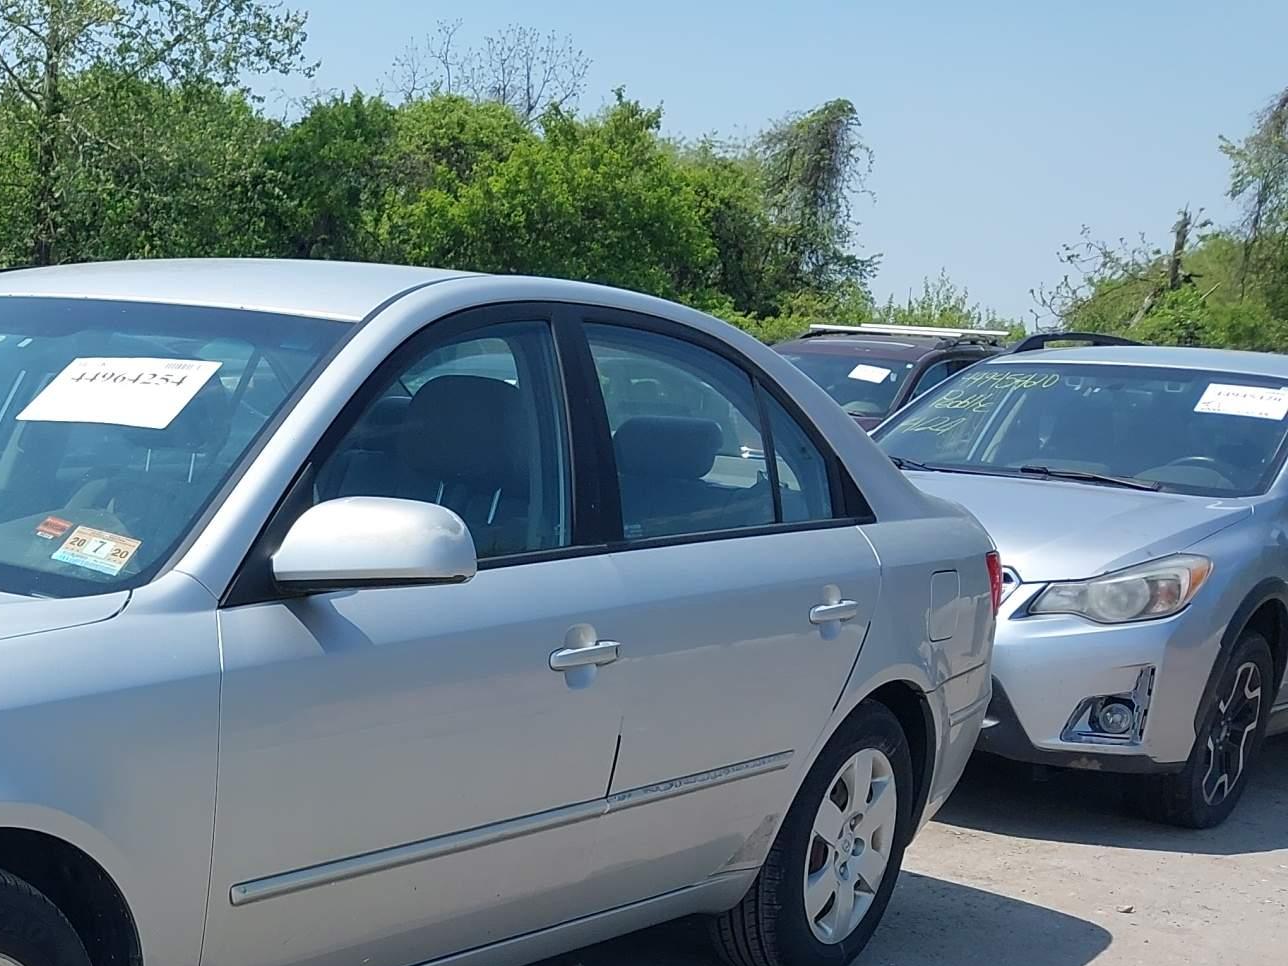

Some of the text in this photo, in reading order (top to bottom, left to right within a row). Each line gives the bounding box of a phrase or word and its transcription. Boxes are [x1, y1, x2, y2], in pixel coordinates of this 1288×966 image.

[71, 371, 189, 386] 44964254
[70, 537, 87, 548] 20
[92, 540, 107, 554] 7
[111, 548, 129, 559] 20
